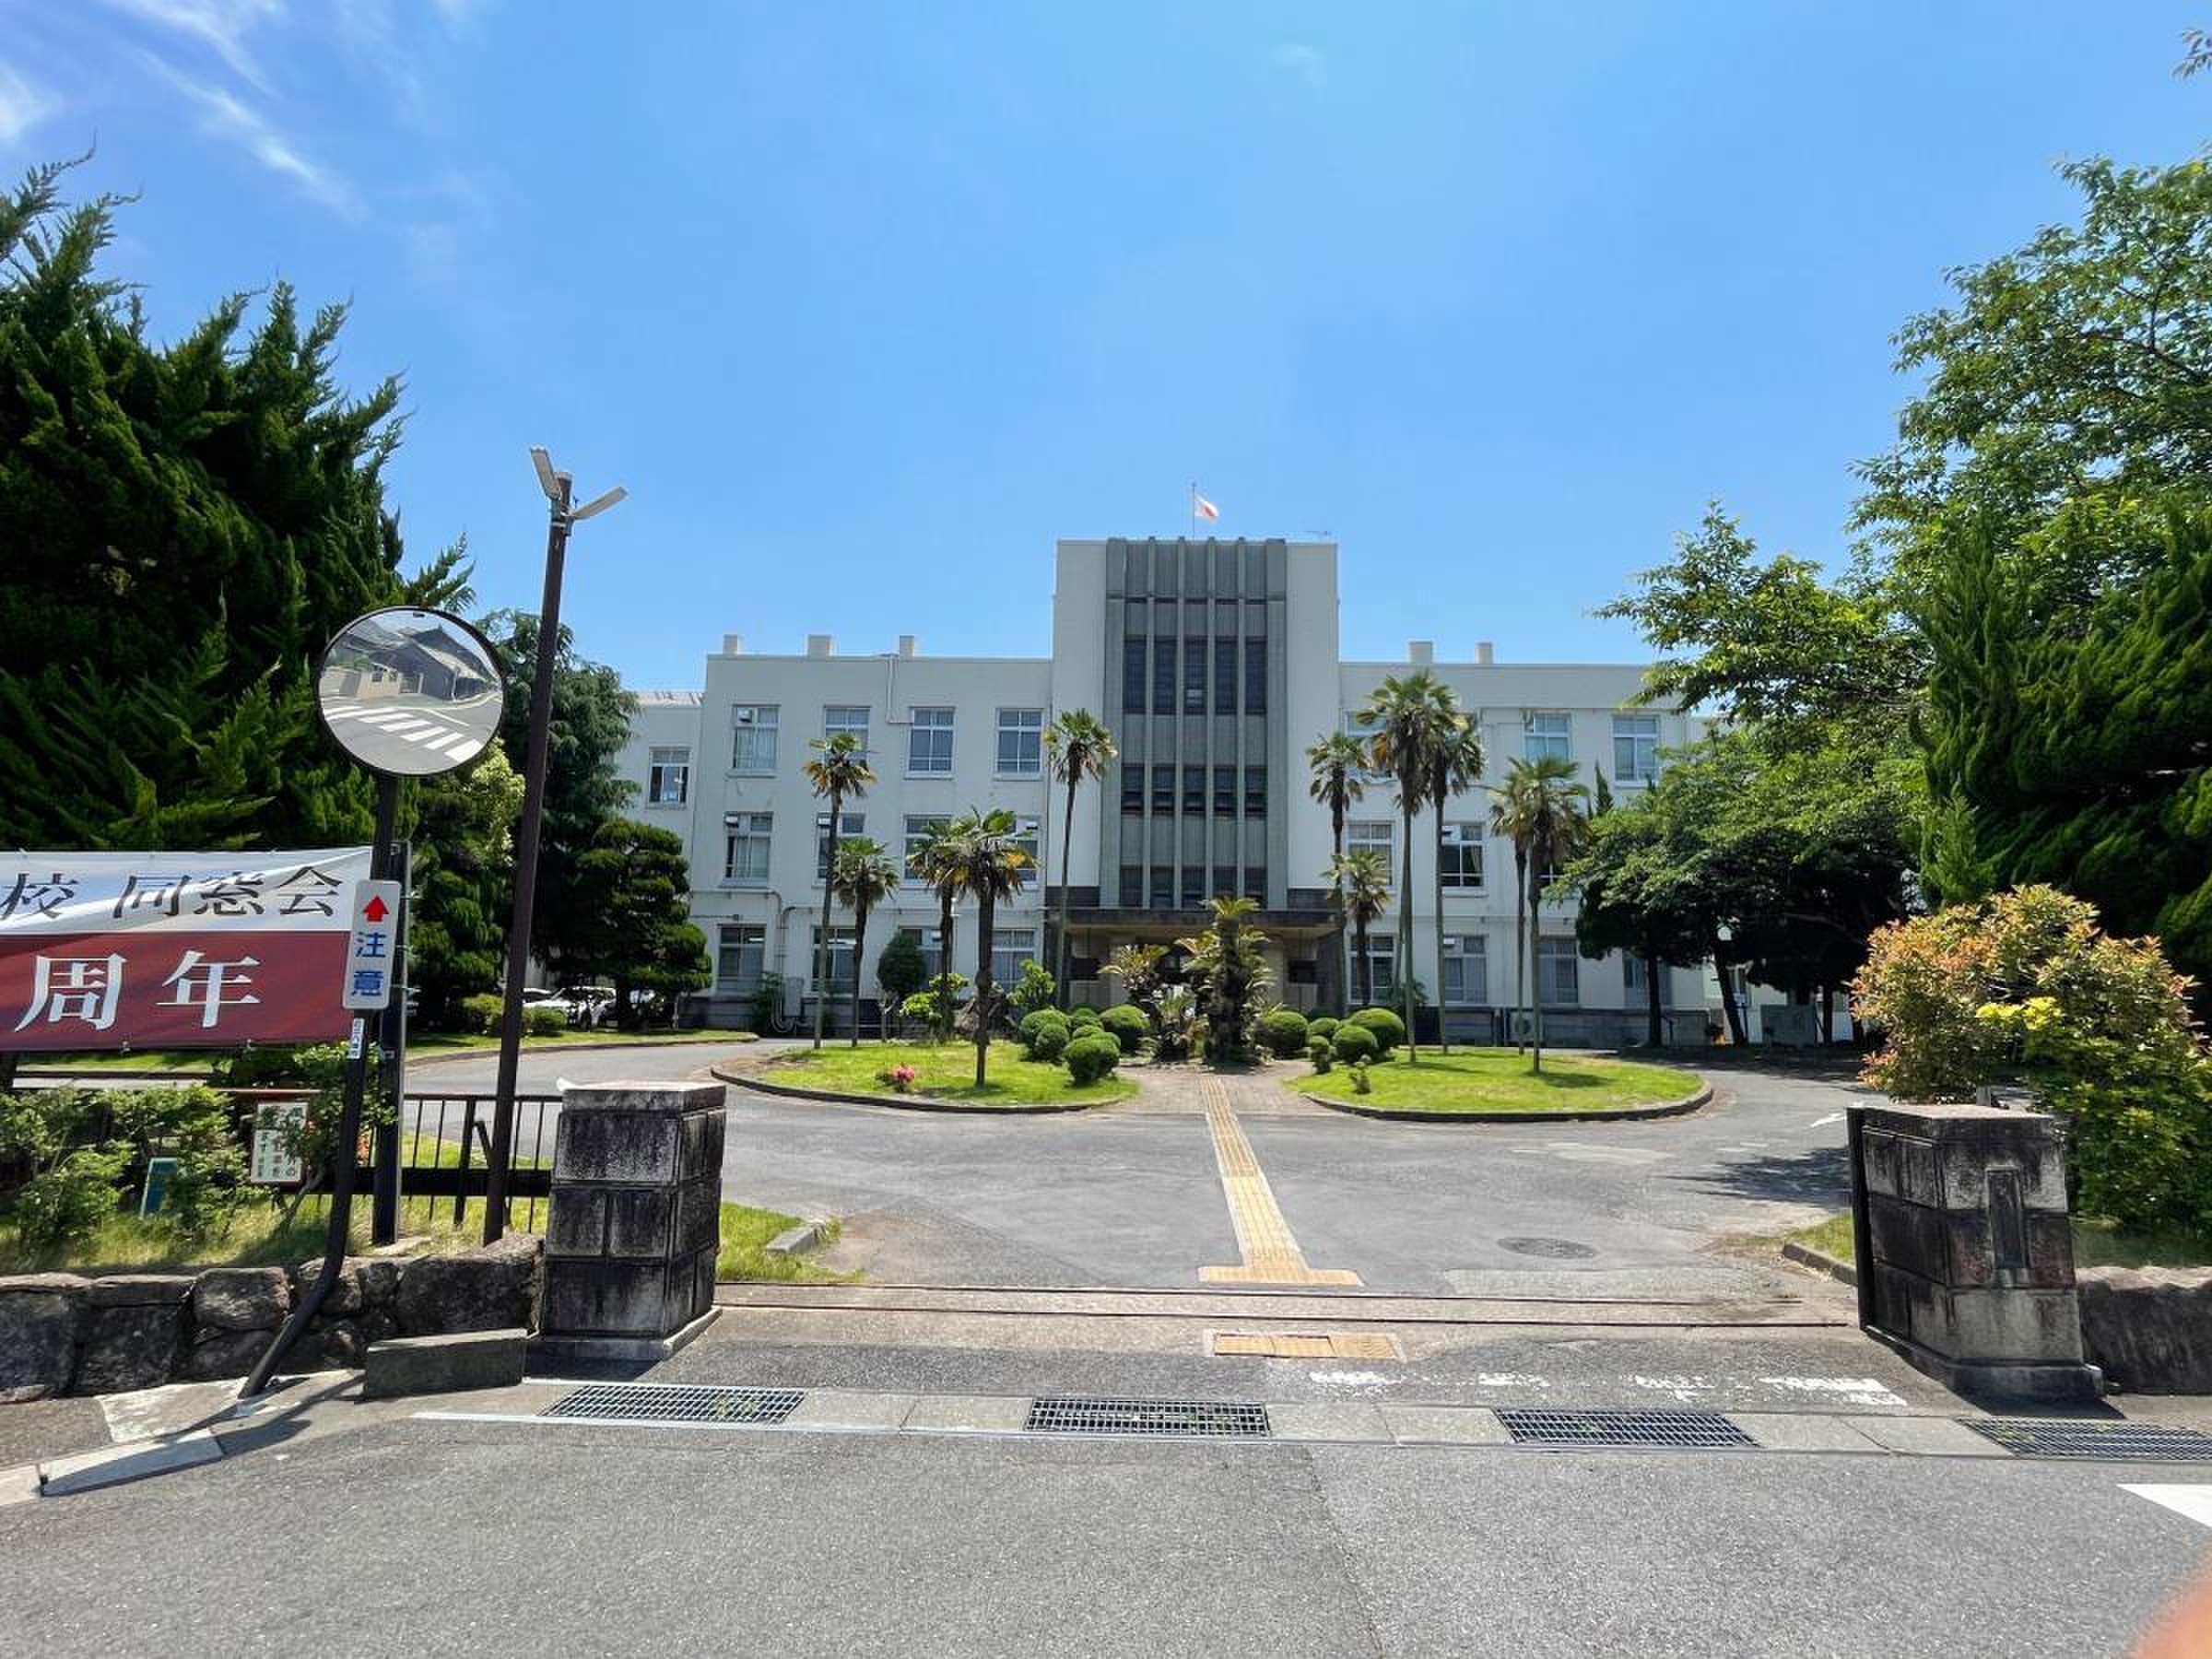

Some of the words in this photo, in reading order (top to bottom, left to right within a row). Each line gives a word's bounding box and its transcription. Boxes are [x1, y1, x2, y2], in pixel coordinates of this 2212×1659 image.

[0, 873, 78, 920] 校
[113, 866, 343, 919] 同窓会
[15, 950, 262, 1032] 周年
[352, 931, 386, 996] 注意
